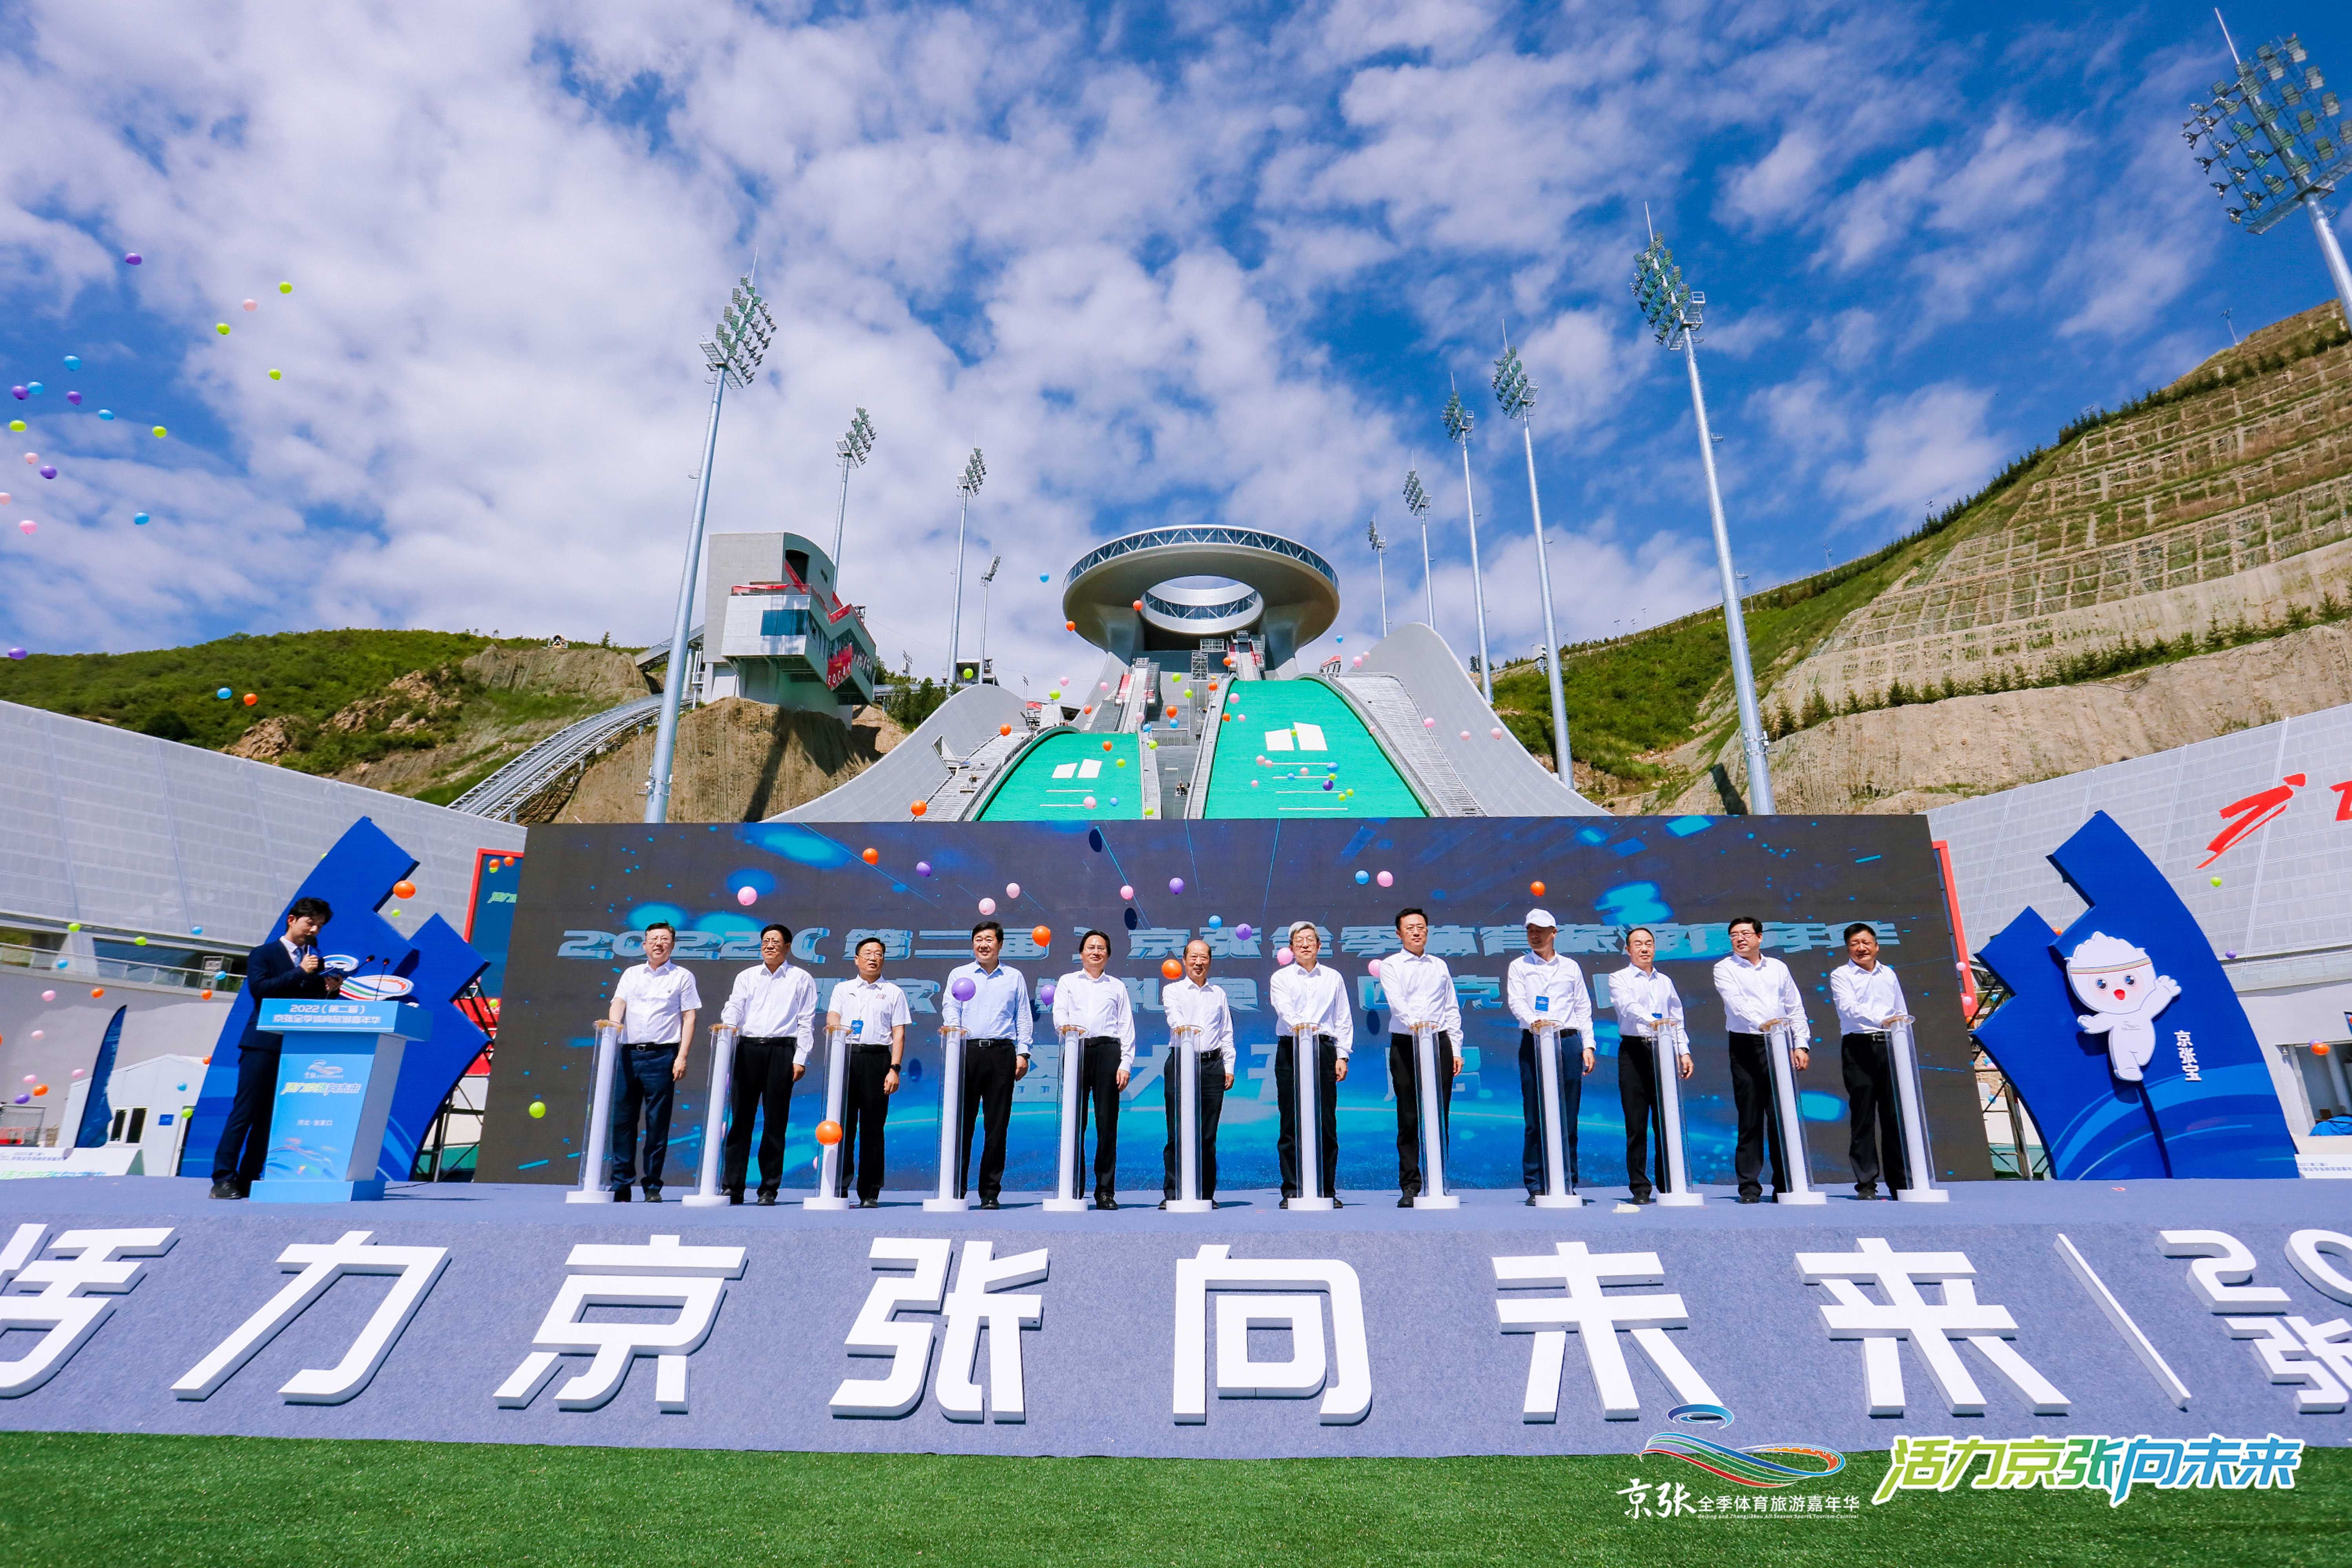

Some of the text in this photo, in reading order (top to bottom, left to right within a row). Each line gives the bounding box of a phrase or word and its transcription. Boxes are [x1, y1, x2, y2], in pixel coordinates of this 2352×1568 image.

[2174, 1030, 2202, 1081] 京张宝
[0, 1223, 2072, 1424] 活力京张向未来
